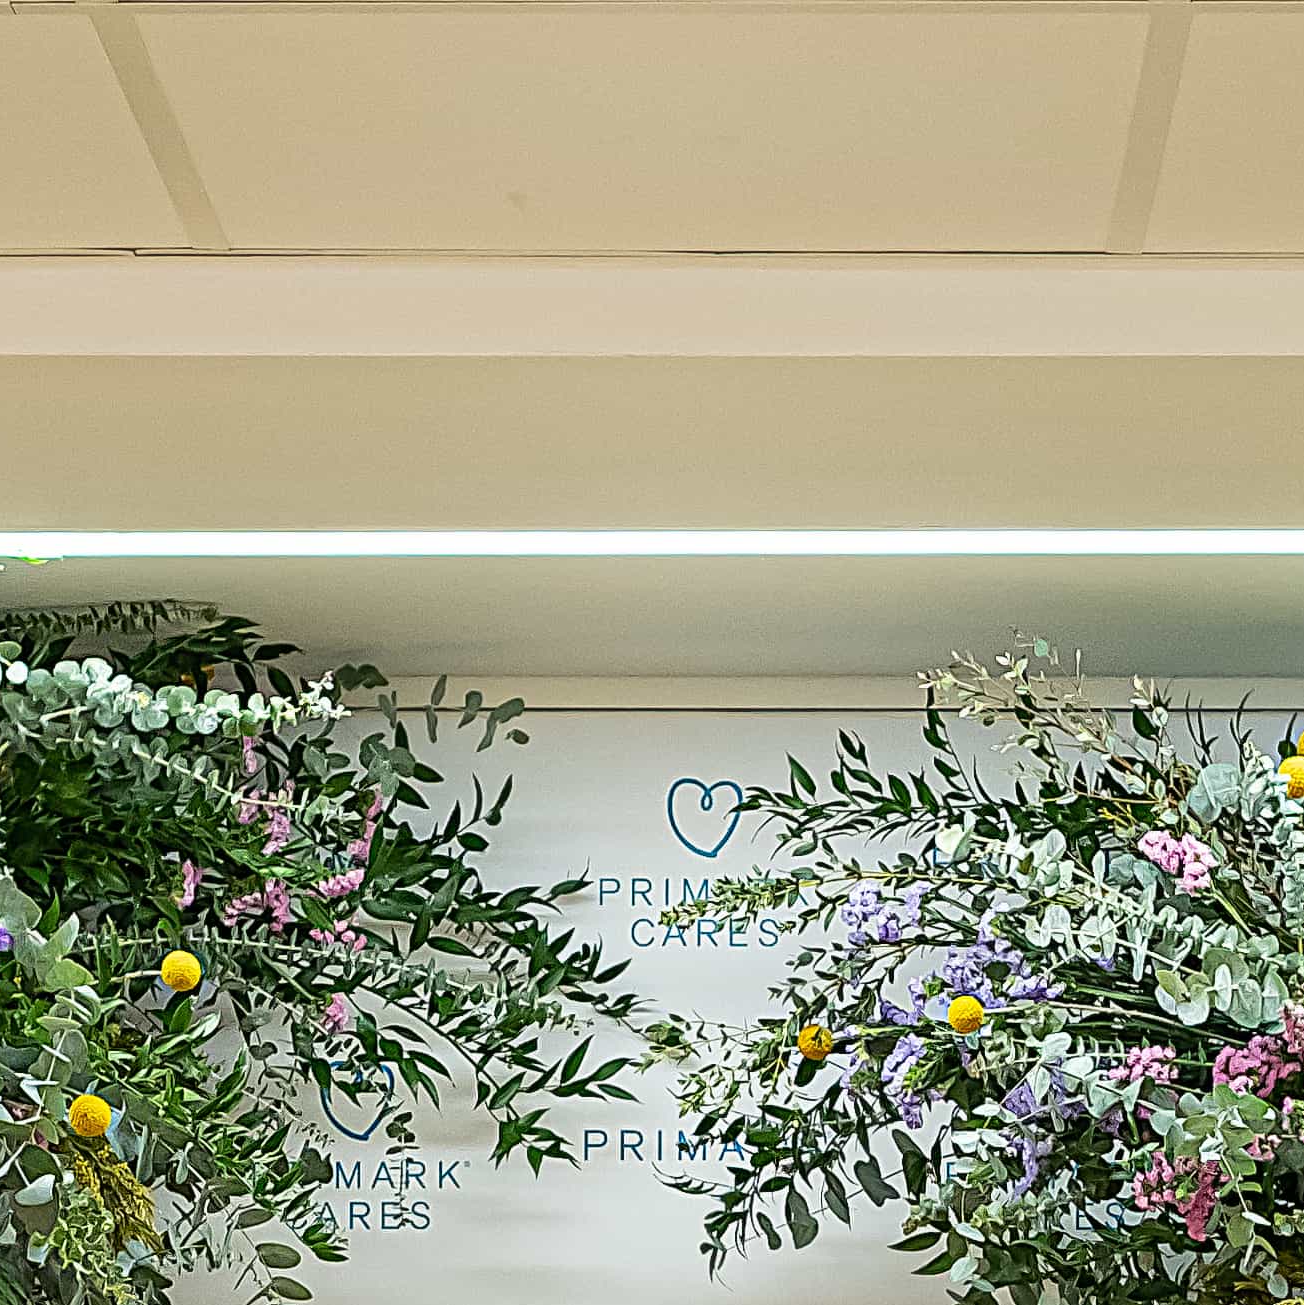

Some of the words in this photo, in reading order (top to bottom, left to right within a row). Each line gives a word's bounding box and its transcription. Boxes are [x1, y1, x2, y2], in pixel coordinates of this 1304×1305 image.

[599, 877, 807, 906] PRIM
[631, 918, 778, 947] CARES
[583, 1130, 745, 1161] PRIMA
[335, 1161, 460, 1189] MARK
[293, 1202, 430, 1230] ARES
